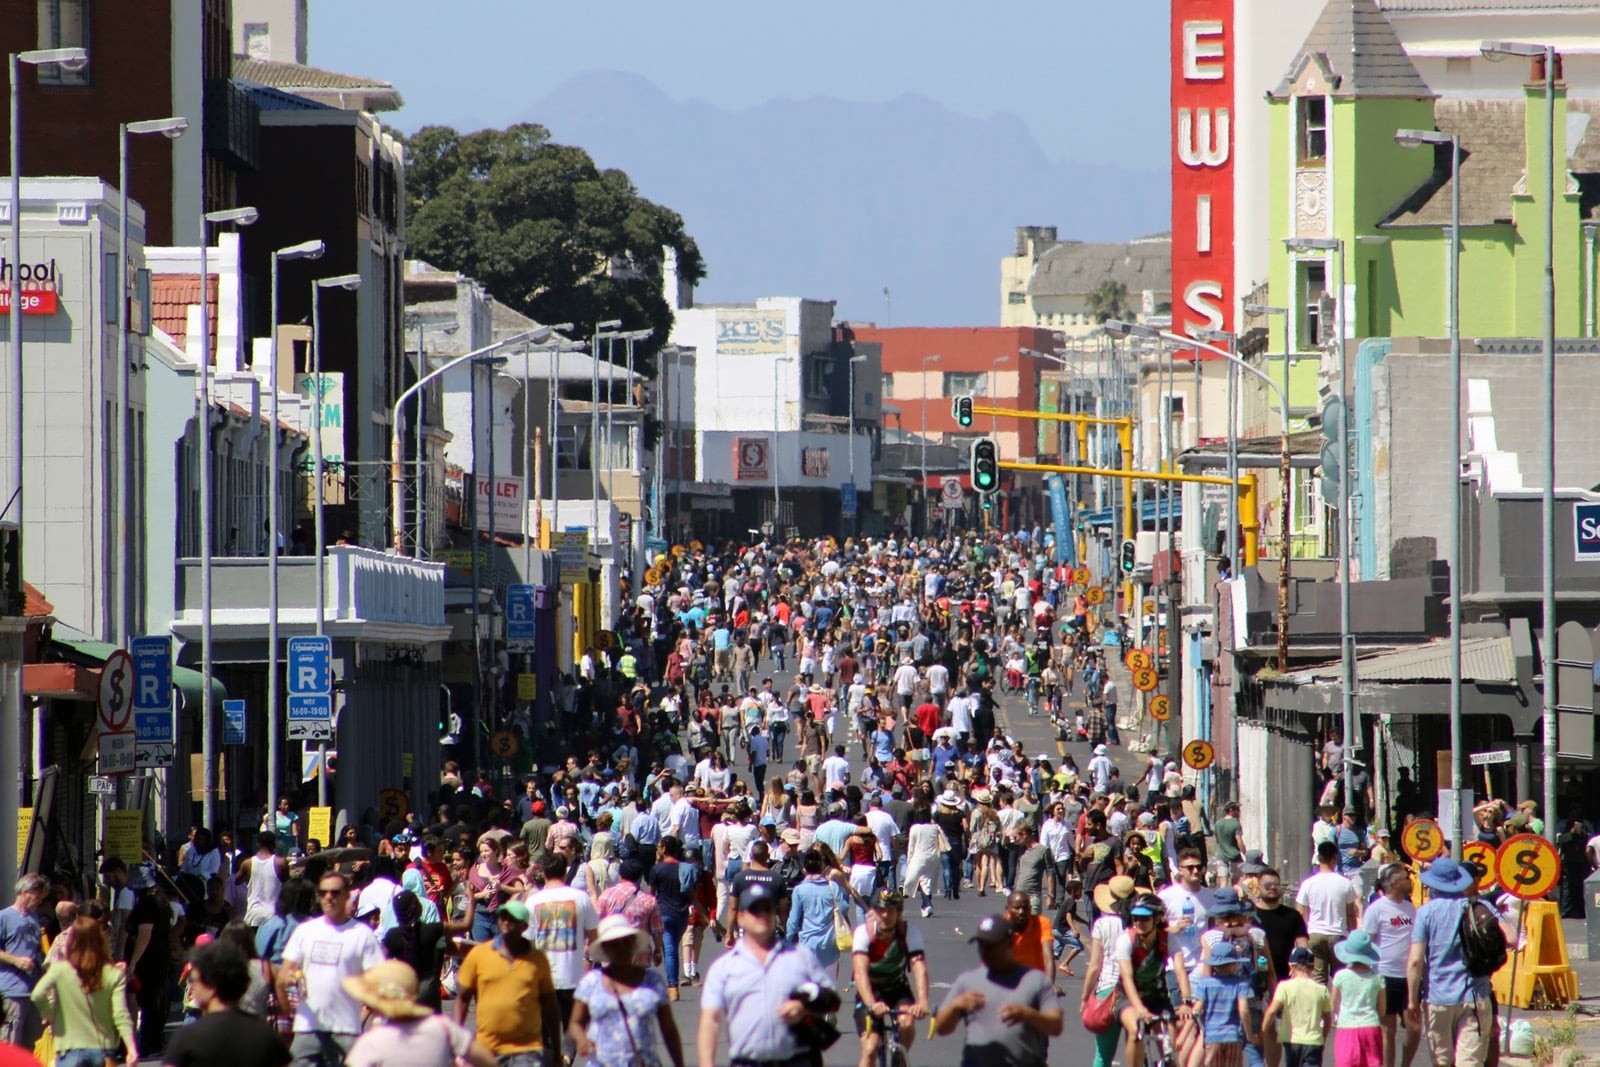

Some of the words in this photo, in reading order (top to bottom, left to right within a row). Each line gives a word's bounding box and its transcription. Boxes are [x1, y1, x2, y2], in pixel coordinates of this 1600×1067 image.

[718, 319, 785, 338] KE'S
[496, 482, 519, 498] LET
[513, 604, 526, 619] R
[298, 667, 317, 690] R
[140, 675, 159, 705] R
